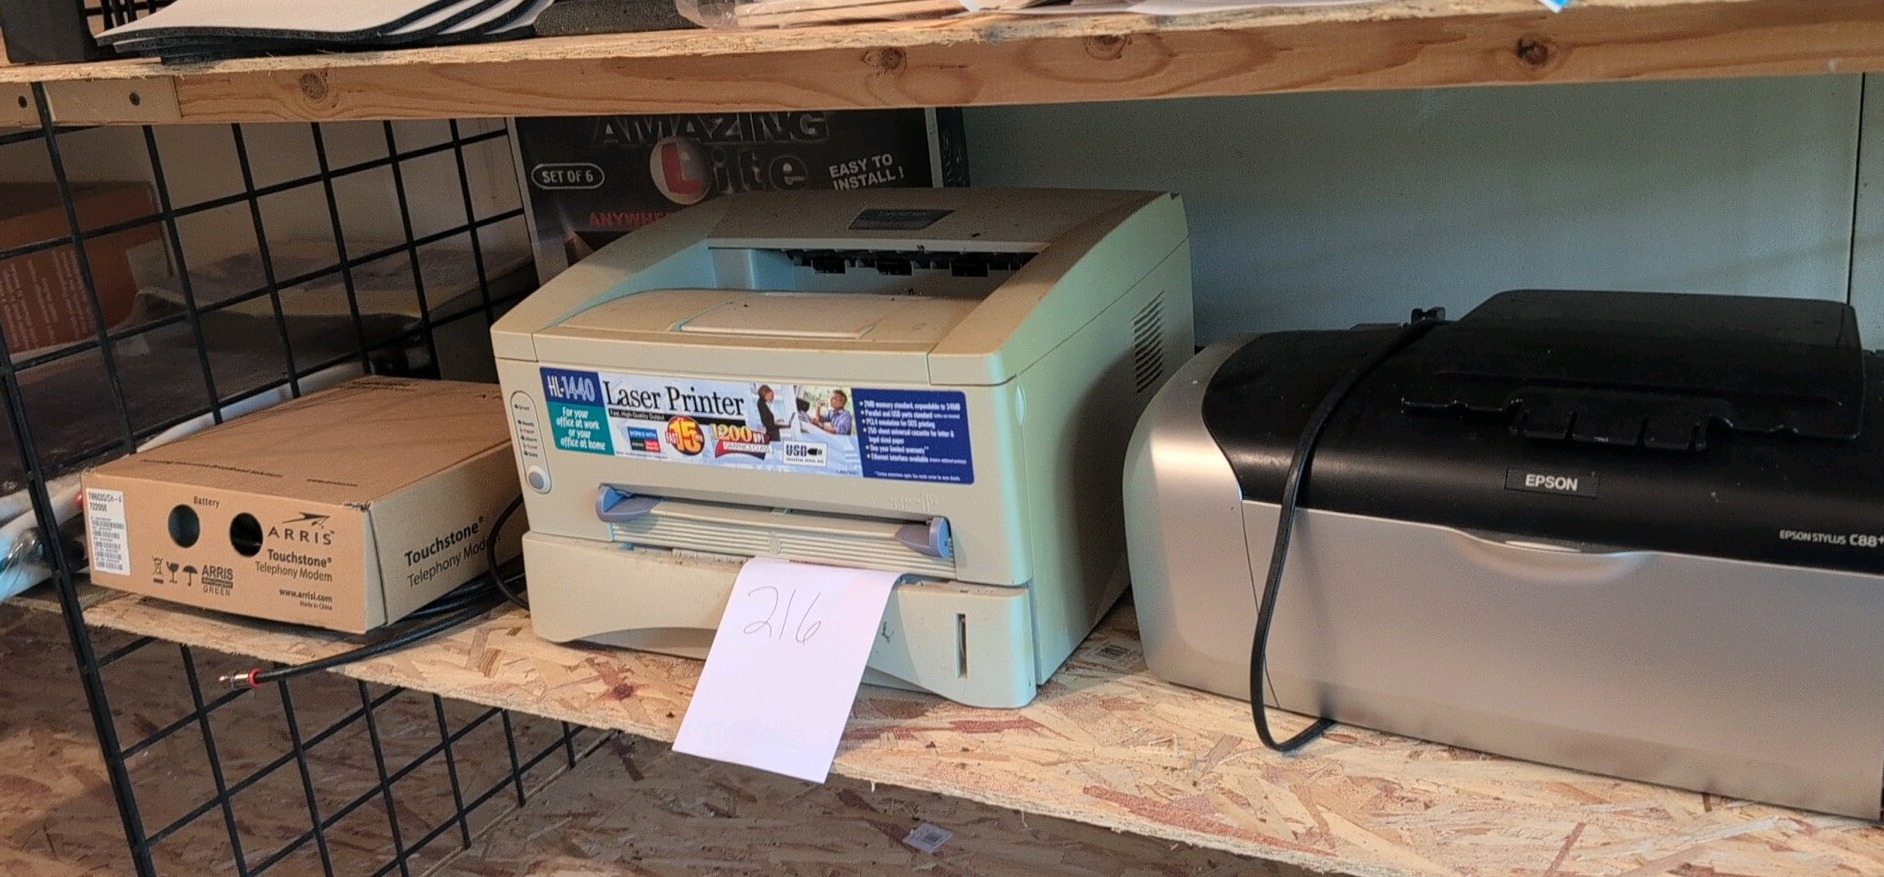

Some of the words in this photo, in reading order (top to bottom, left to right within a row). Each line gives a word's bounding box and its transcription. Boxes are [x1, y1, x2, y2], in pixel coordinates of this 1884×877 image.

[593, 113, 830, 145] AMAZING
[829, 158, 867, 178] EASY
[872, 153, 893, 167] TO
[542, 170, 563, 183] SET
[567, 170, 582, 183] OF
[586, 170, 593, 183] 6
[833, 166, 896, 191] INSTALL
[547, 375, 595, 402] HL-1440
[603, 380, 664, 410] Laser
[665, 386, 744, 416] Printer
[562, 406, 573, 416] For
[574, 409, 588, 419] your
[556, 417, 574, 428] office
[575, 419, 583, 429] at
[584, 420, 600, 430] work
[710, 423, 752, 443] 1200
[568, 428, 575, 436] or
[577, 430, 591, 439] your
[669, 420, 701, 453] 15
[560, 438, 579, 448] office
[580, 440, 587, 449] at
[588, 441, 606, 450] home
[786, 444, 807, 457] USB
[1525, 474, 1578, 491] EPSON
[194, 495, 219, 509] Battery
[268, 526, 332, 545] ARRIS
[1779, 529, 1811, 542] EPSON
[1811, 532, 1847, 545] STYLUS
[1849, 534, 1884, 548] C88+
[202, 564, 233, 581] ARRIS
[255, 561, 298, 579] Telephony
[300, 568, 332, 582] Modem
[407, 552, 462, 588] Telephony
[203, 585, 230, 597] GREEN
[744, 586, 821, 646] 216
